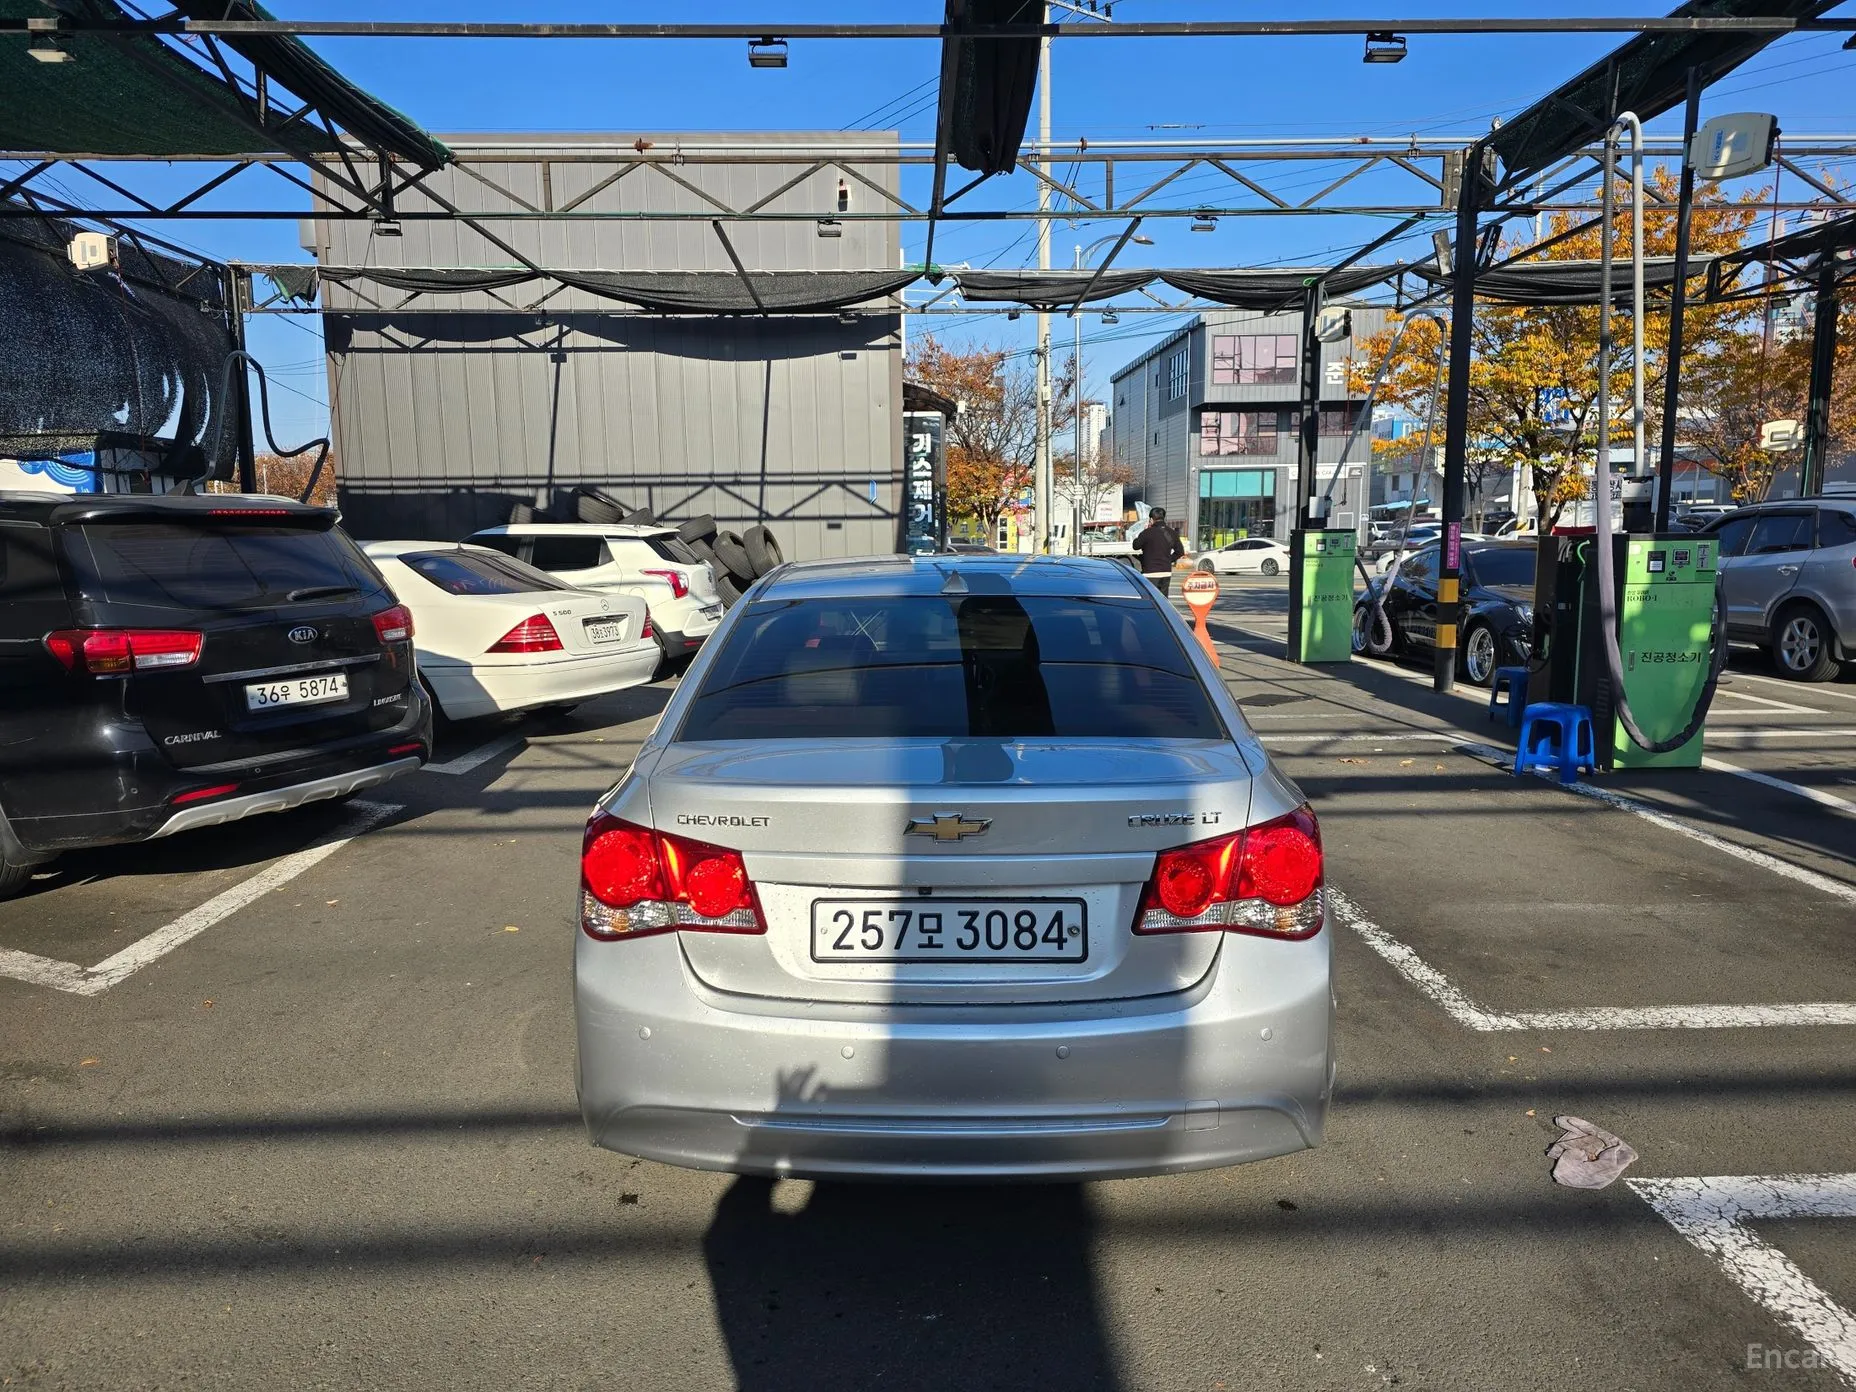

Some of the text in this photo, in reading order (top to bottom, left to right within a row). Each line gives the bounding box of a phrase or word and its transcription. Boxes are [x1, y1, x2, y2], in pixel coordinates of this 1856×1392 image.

[1188, 581, 1214, 590] 주차금지
[1313, 594, 1348, 602] 진공청소기
[294, 629, 314, 641] KIA
[1640, 652, 1702, 663] 진공청소기
[257, 677, 339, 705] 36우 5874
[164, 730, 222, 745] CARNIVAL
[677, 814, 770, 827] CHEVROLET
[1128, 812, 1222, 827] CRUZE LT
[832, 909, 1068, 951] 257모 3084
